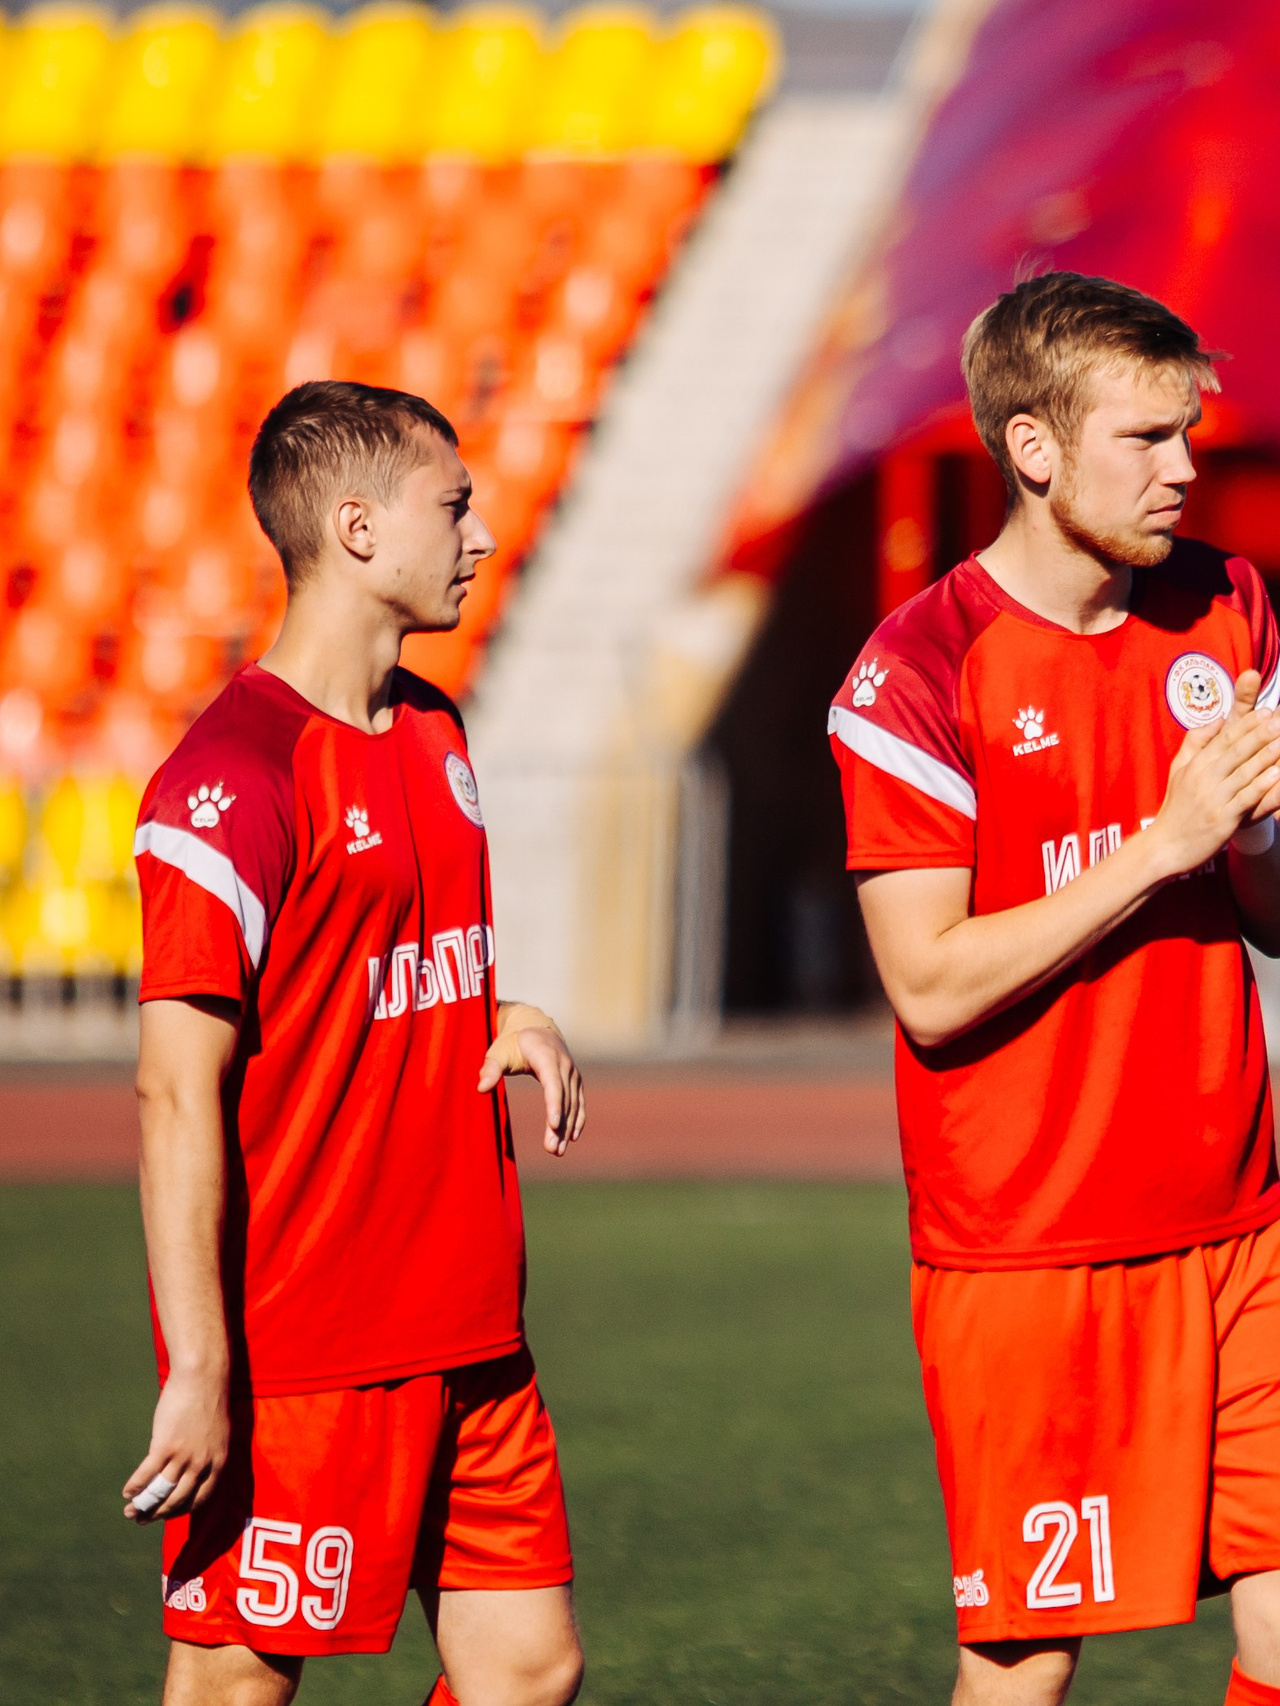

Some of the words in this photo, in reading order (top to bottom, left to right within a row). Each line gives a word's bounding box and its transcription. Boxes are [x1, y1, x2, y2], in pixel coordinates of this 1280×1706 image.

[1012, 732, 1060, 757] KELME
[346, 831, 383, 856] KELME
[236, 1516, 355, 1631] 59
[1022, 1494, 1116, 1610] 21
